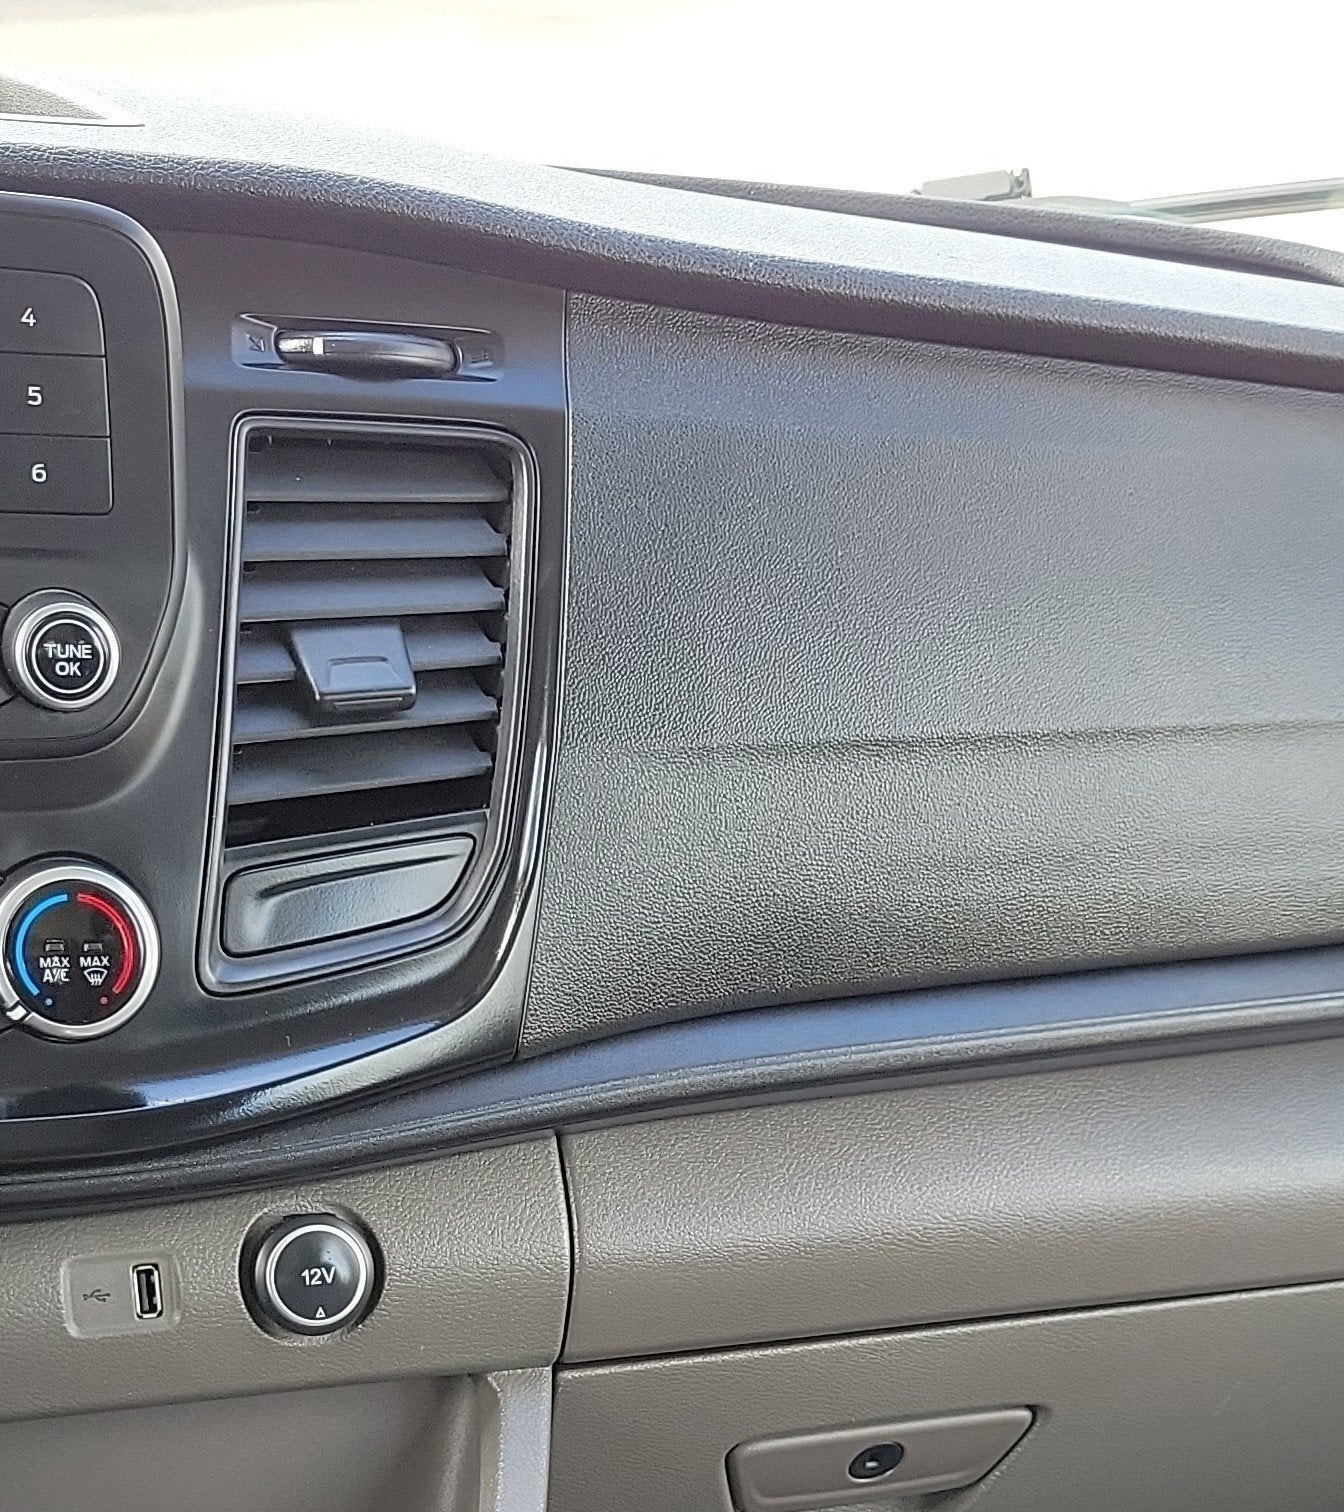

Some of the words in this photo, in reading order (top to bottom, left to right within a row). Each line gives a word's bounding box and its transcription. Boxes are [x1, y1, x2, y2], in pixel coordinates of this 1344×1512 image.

[20, 307, 37, 327] 4
[27, 386, 42, 406] 5
[31, 463, 47, 483] 6
[43, 642, 93, 661] TUNE
[54, 661, 82, 678] OK
[39, 956, 71, 968] MAX
[79, 955, 111, 968] MAX
[42, 968, 71, 983] A/C
[300, 1266, 337, 1287] 12V
